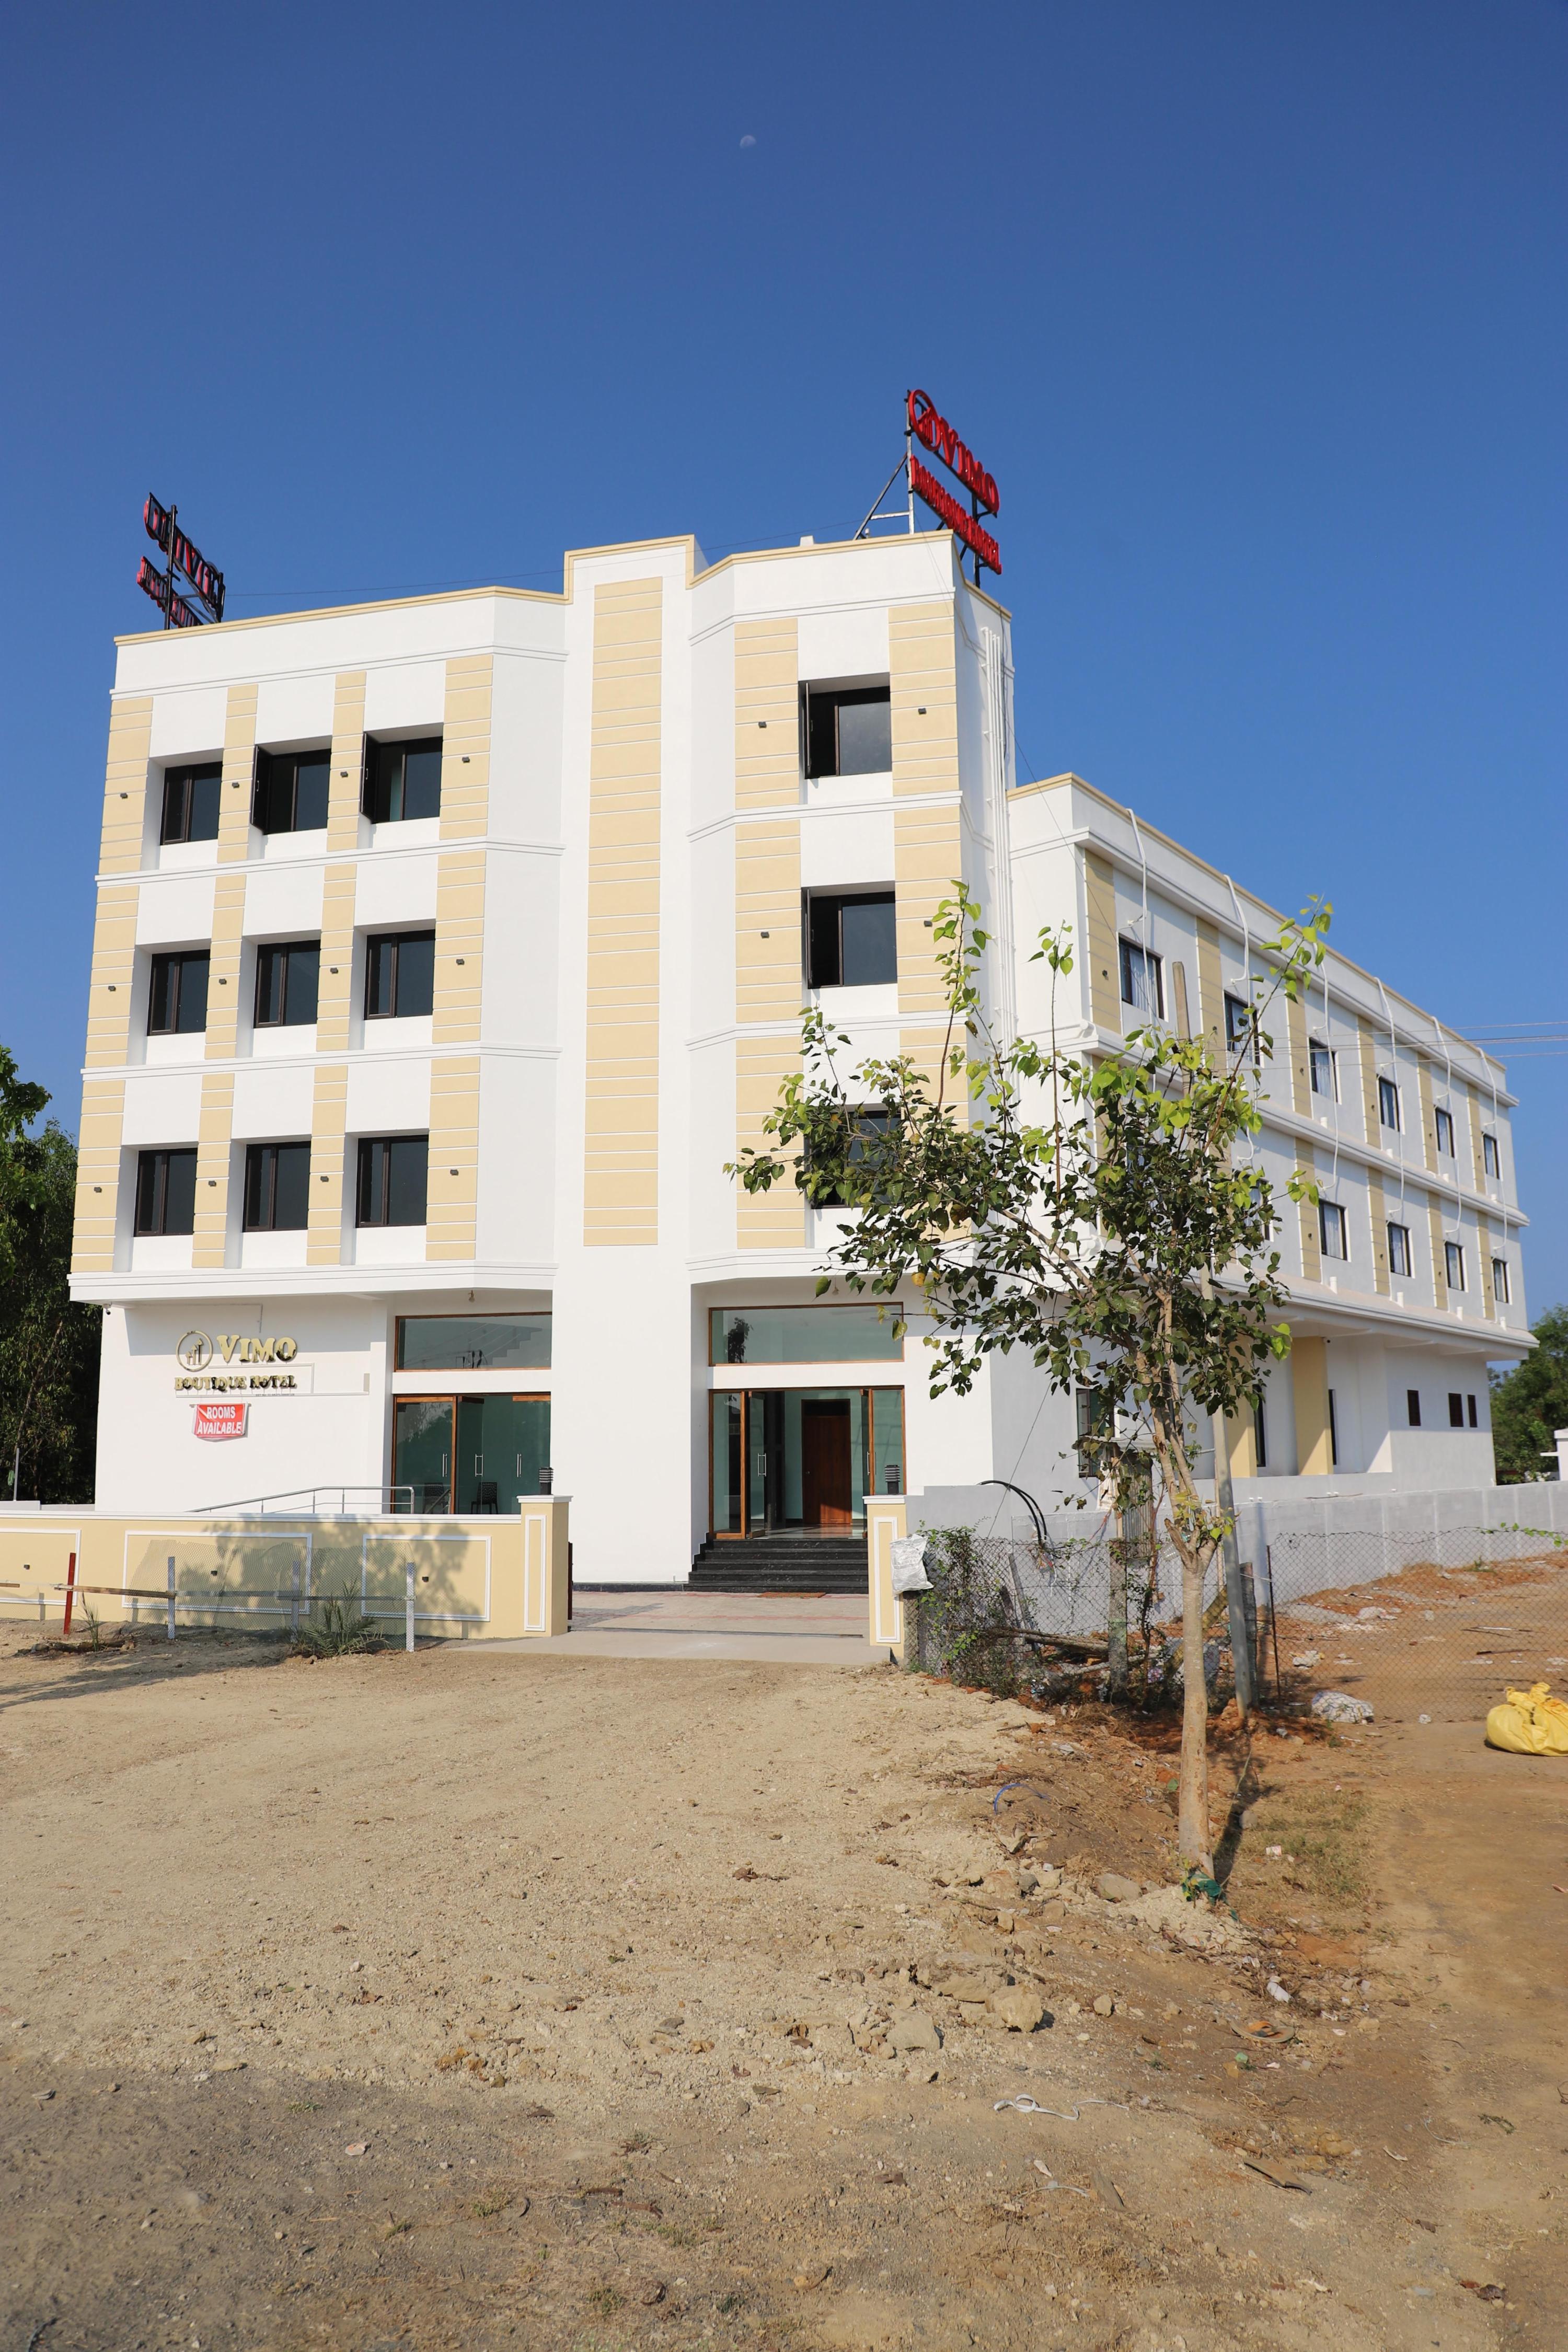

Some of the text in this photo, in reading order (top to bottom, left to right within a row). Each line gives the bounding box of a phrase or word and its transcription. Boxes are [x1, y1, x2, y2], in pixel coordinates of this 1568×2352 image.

[939, 417, 999, 513] VIMO
[216, 1335, 297, 1363] VIMO
[175, 1375, 296, 1392] BOUTIQUE HOTEL
[206, 1406, 236, 1419] ROOMS
[196, 1421, 242, 1434] AVAILABLE
